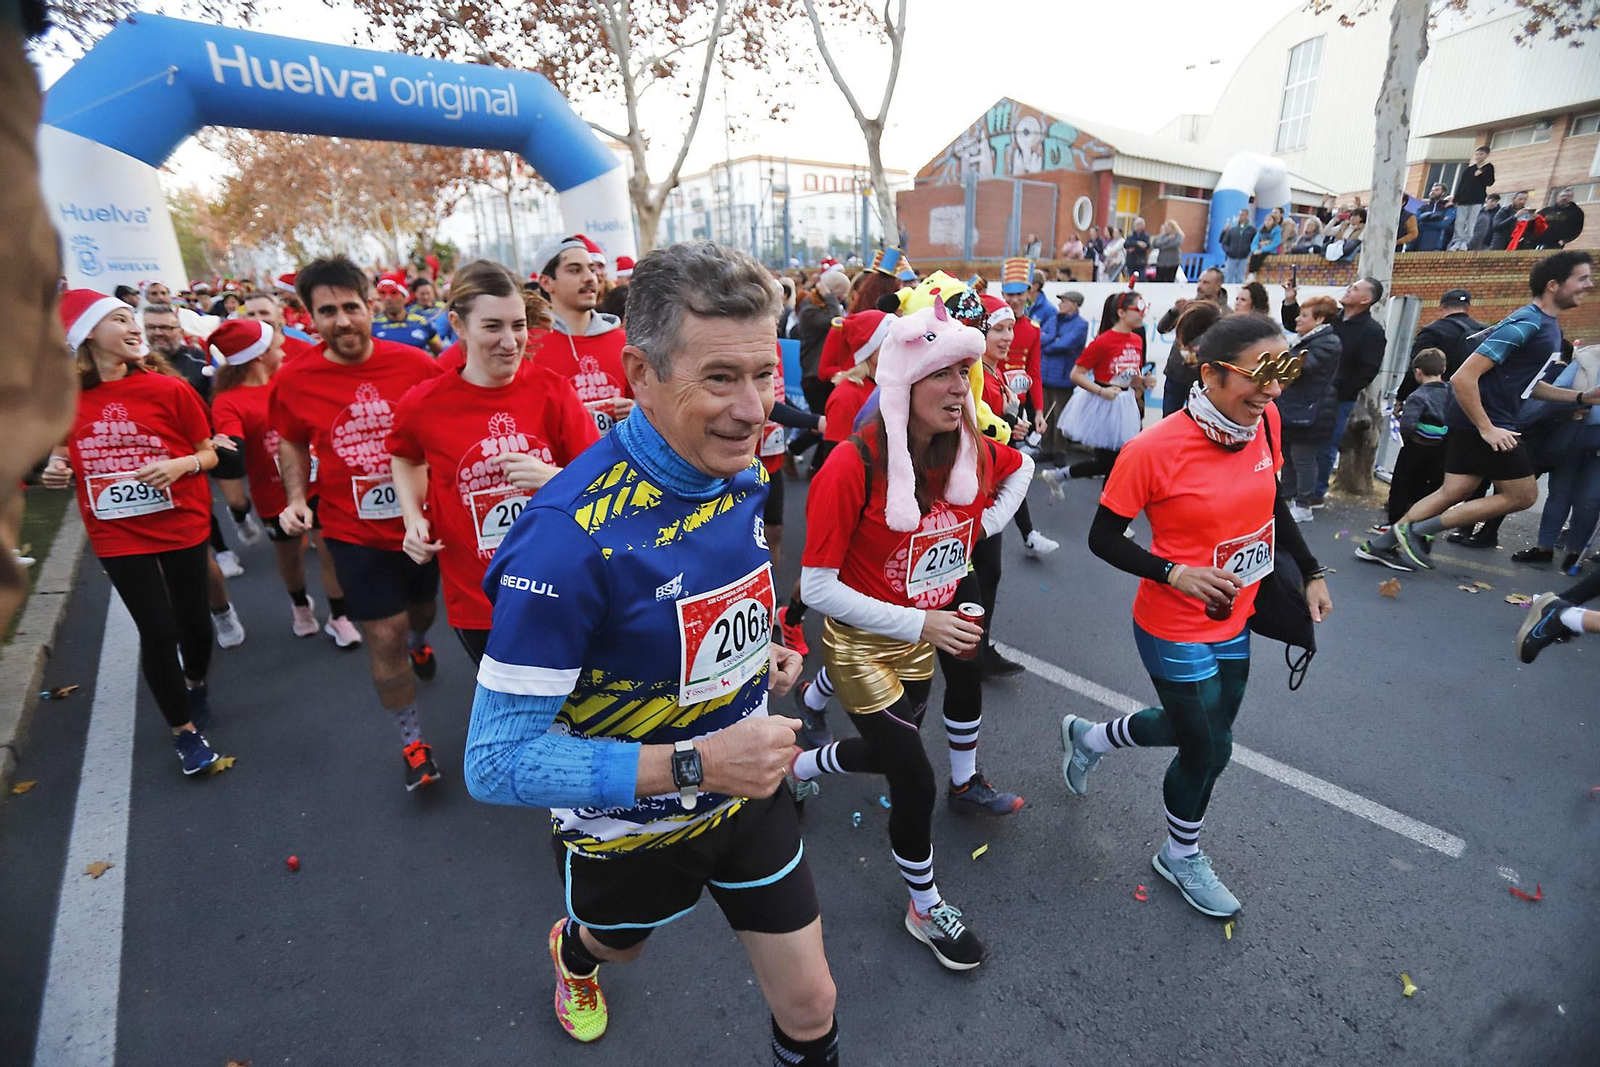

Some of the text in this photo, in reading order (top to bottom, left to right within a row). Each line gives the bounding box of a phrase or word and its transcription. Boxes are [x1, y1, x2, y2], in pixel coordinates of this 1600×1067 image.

[205, 40, 518, 120] Huelva original
[60, 203, 148, 223] Huelva
[481, 433, 530, 457] XIII
[110, 483, 149, 503] 529
[926, 541, 960, 571] 275
[1233, 543, 1264, 573] 276
[714, 602, 759, 664] 206
